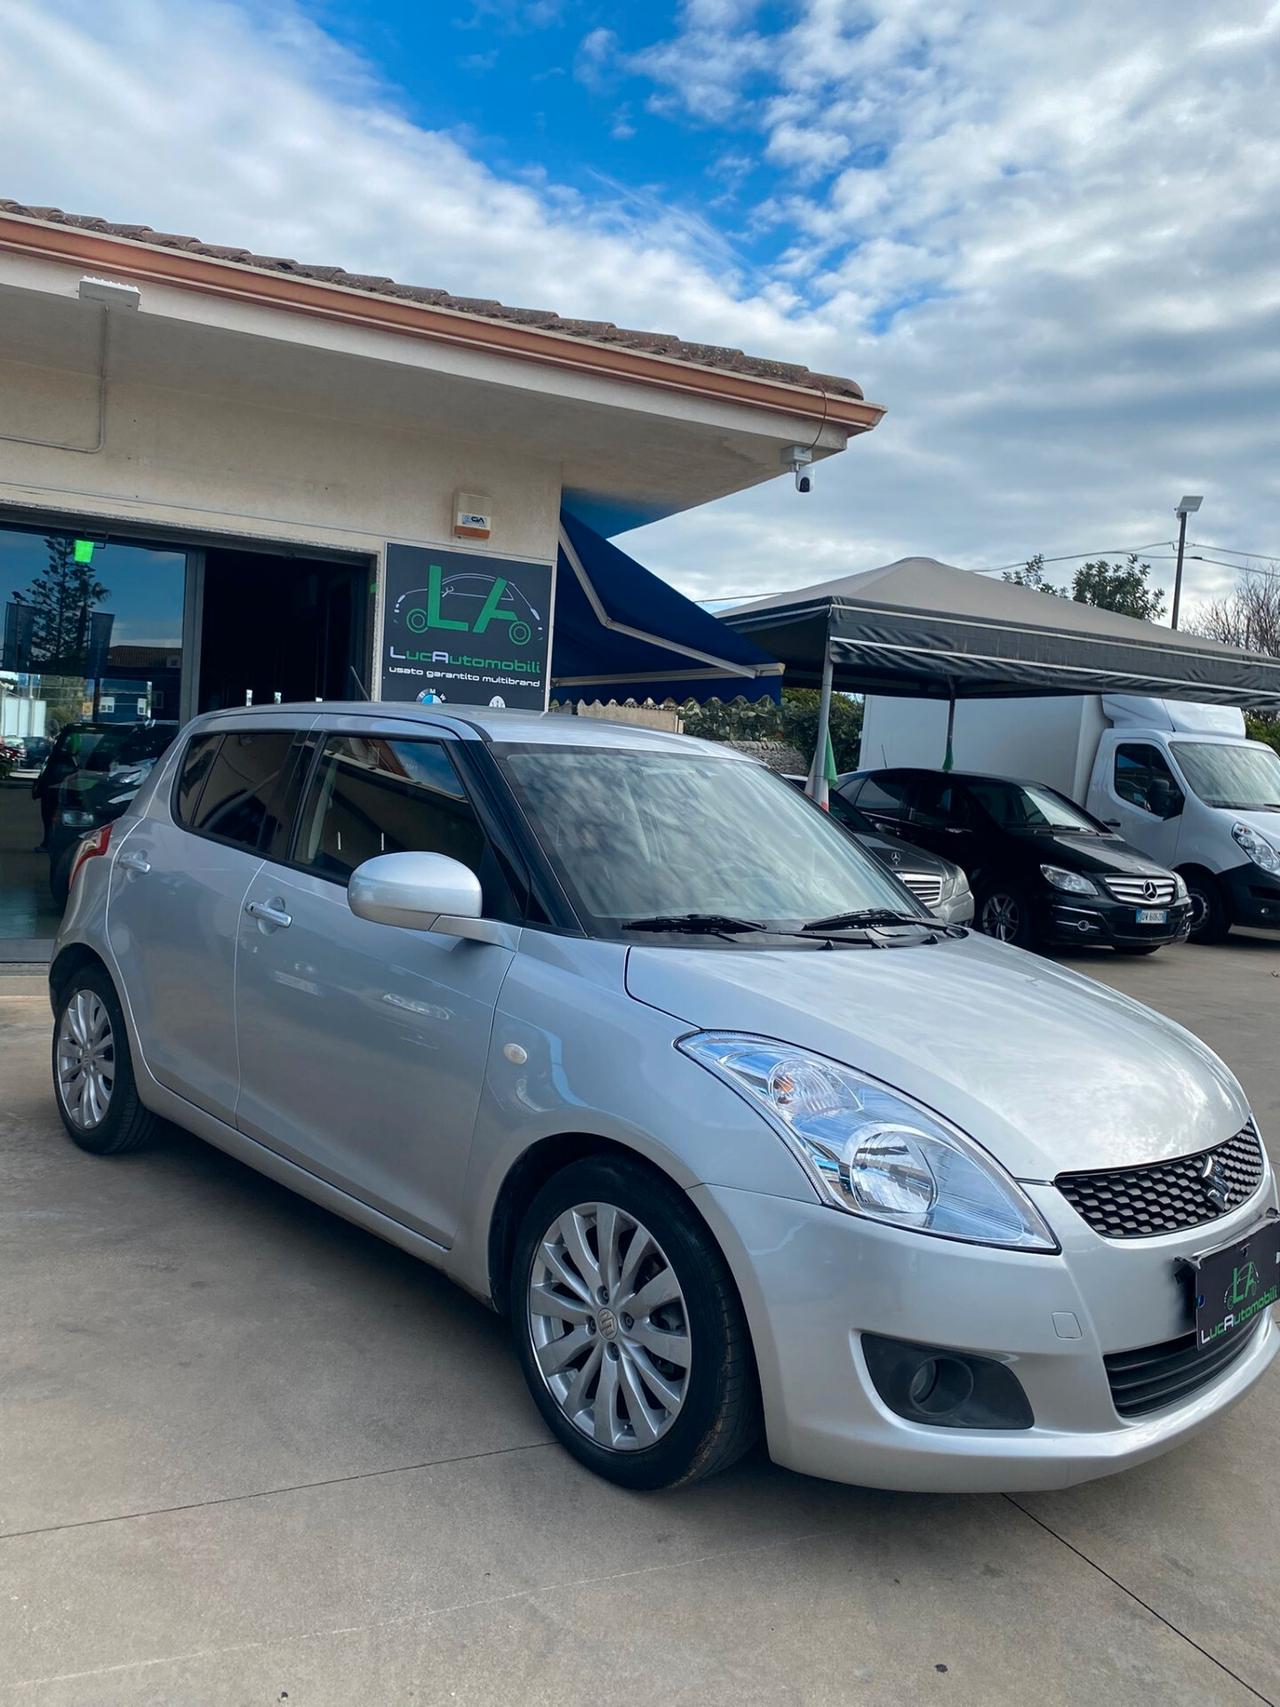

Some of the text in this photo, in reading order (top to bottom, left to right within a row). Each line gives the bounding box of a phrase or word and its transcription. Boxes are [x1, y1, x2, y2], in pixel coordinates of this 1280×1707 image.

[389, 646, 541, 674] LucAutomobili
[389, 666, 541, 688] usato garantito multibrand
[1201, 1285, 1278, 1344] LucAutomobili
